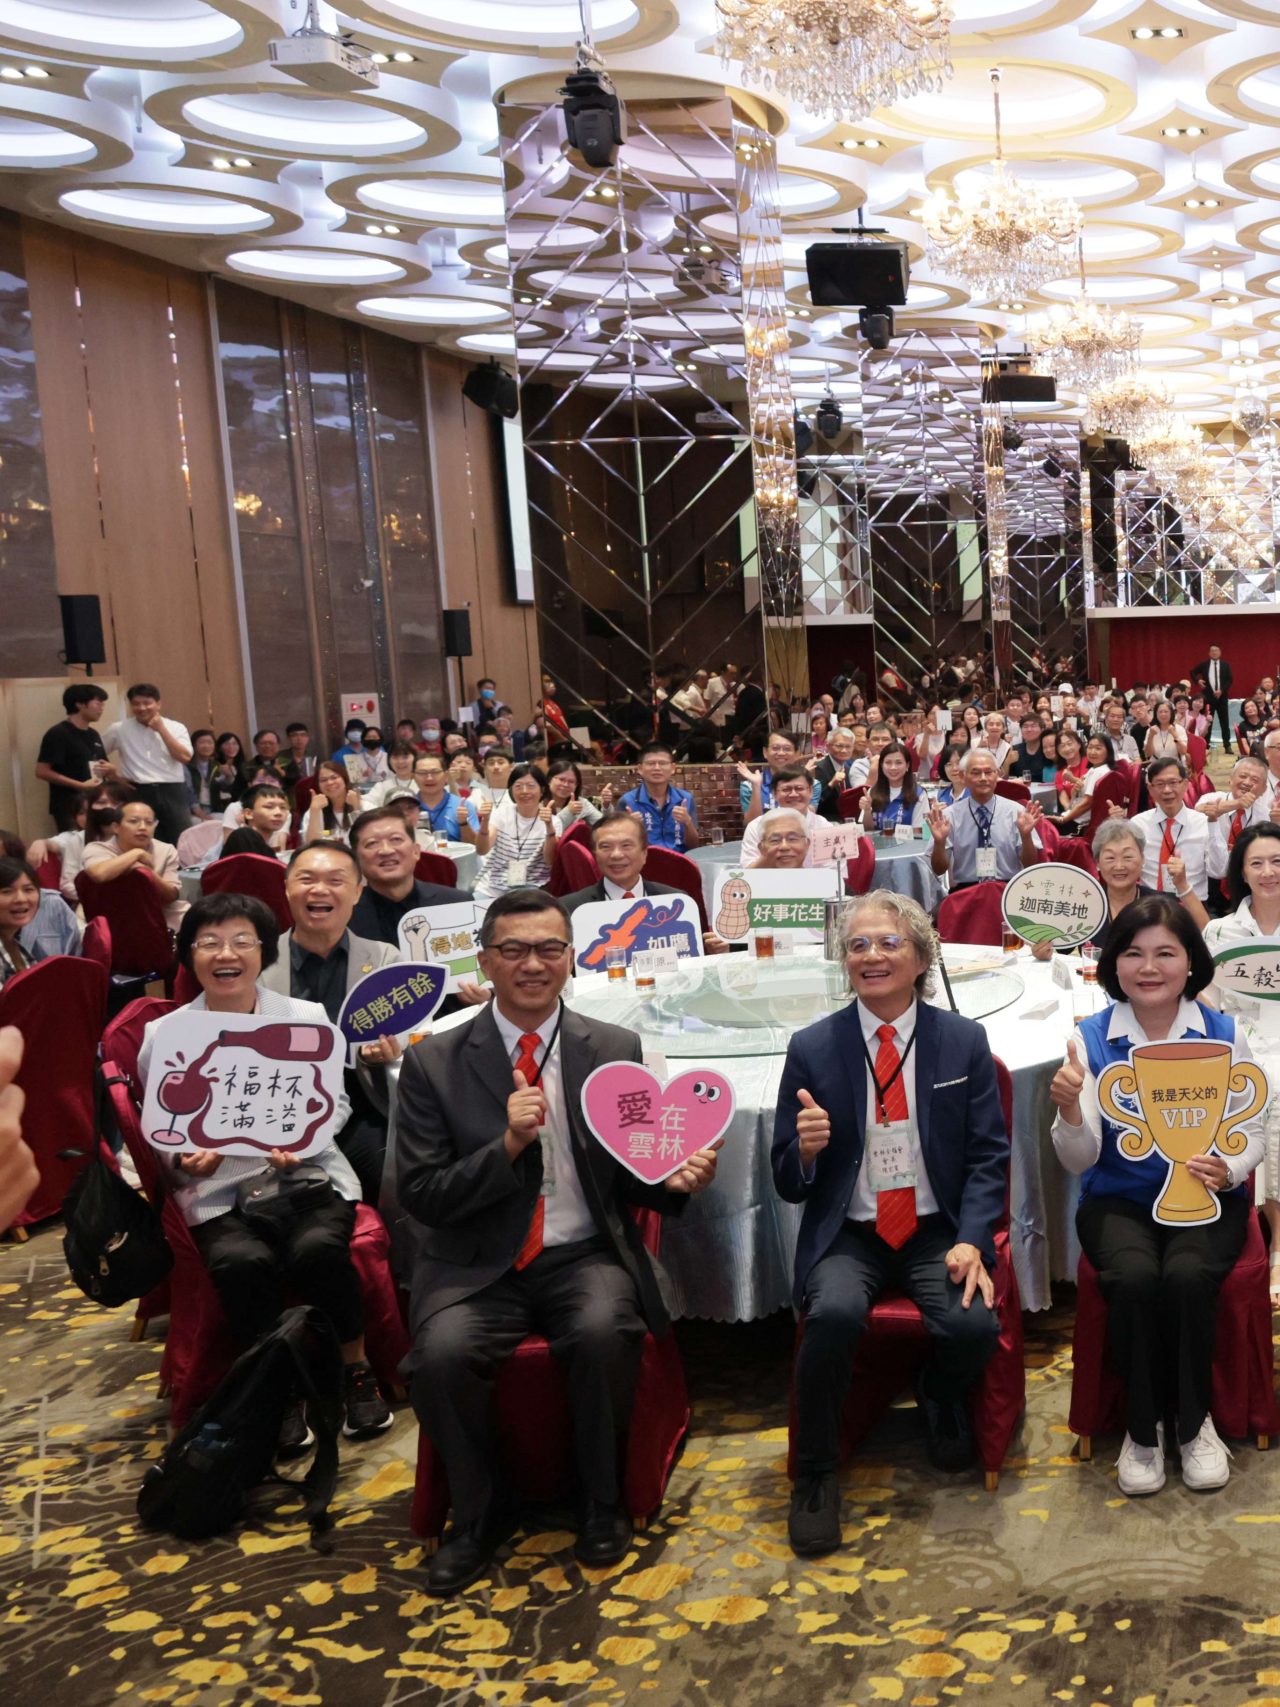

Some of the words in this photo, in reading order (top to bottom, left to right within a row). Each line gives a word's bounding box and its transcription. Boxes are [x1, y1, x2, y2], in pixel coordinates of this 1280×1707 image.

[1041, 880, 1073, 896] 雲林
[753, 903, 825, 922] 好事花生
[1019, 896, 1088, 919] 迦南美地
[348, 972, 436, 1035] 得勝有餘
[223, 1064, 303, 1098] 福杯
[1151, 1085, 1218, 1103] 我是天父的
[219, 1100, 297, 1133] 滿溢
[1160, 1107, 1207, 1129] VIP
[628, 1132, 685, 1161] 雲林
